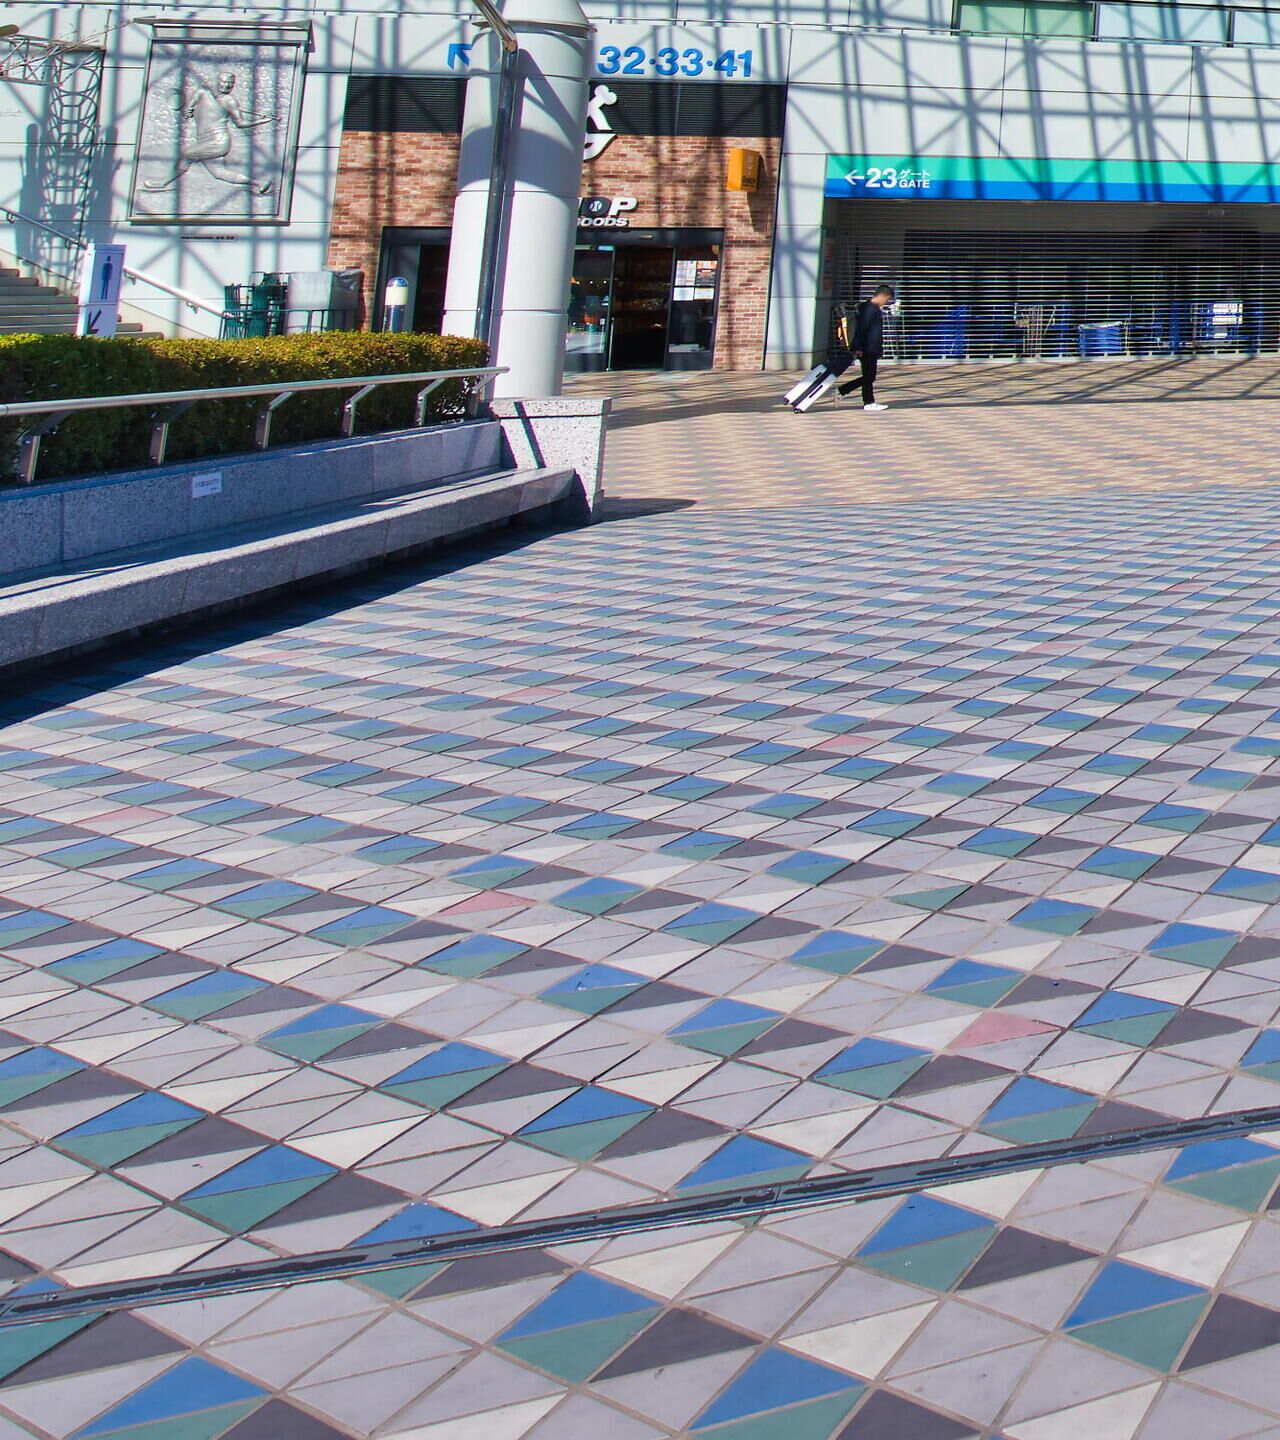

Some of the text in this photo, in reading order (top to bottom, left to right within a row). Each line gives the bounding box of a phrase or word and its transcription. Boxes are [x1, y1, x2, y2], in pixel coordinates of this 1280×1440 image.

[865, 168, 897, 188] 23
[900, 168, 930, 180] ゲート
[899, 179, 930, 188] GATE
[576, 216, 629, 227] OODS
